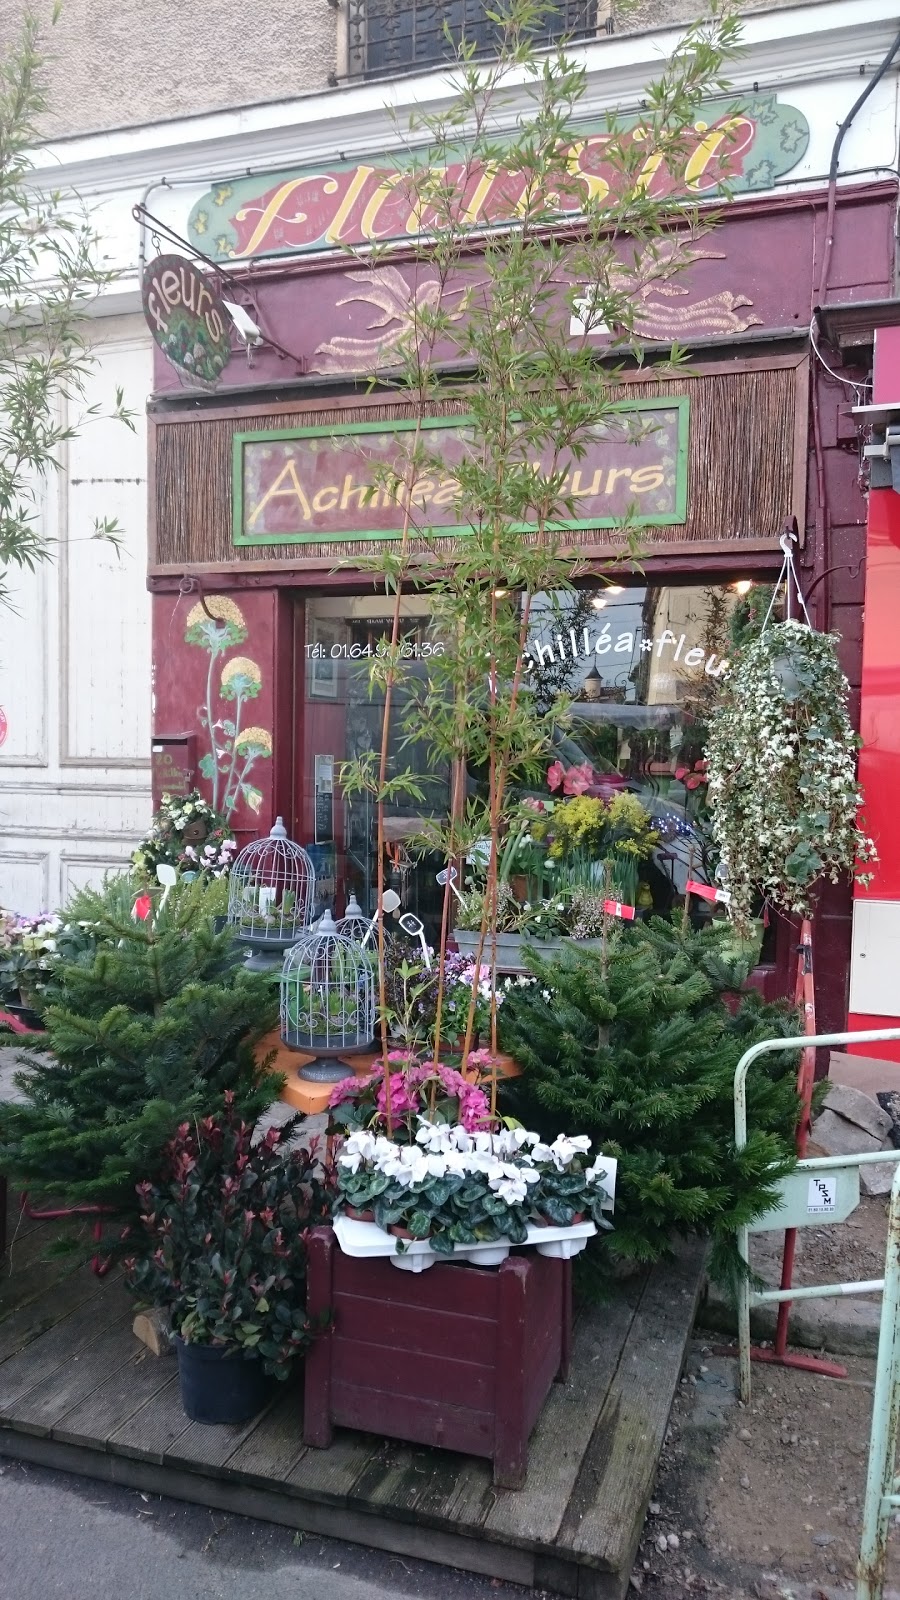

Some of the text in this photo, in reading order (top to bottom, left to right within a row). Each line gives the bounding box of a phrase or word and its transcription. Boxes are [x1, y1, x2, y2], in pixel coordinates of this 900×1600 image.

[148, 266, 224, 343] fleurs
[503, 461, 665, 498] eurs
[303, 641, 446, 659] Tél: 01.64.961.36
[655, 629, 733, 681] fleu
